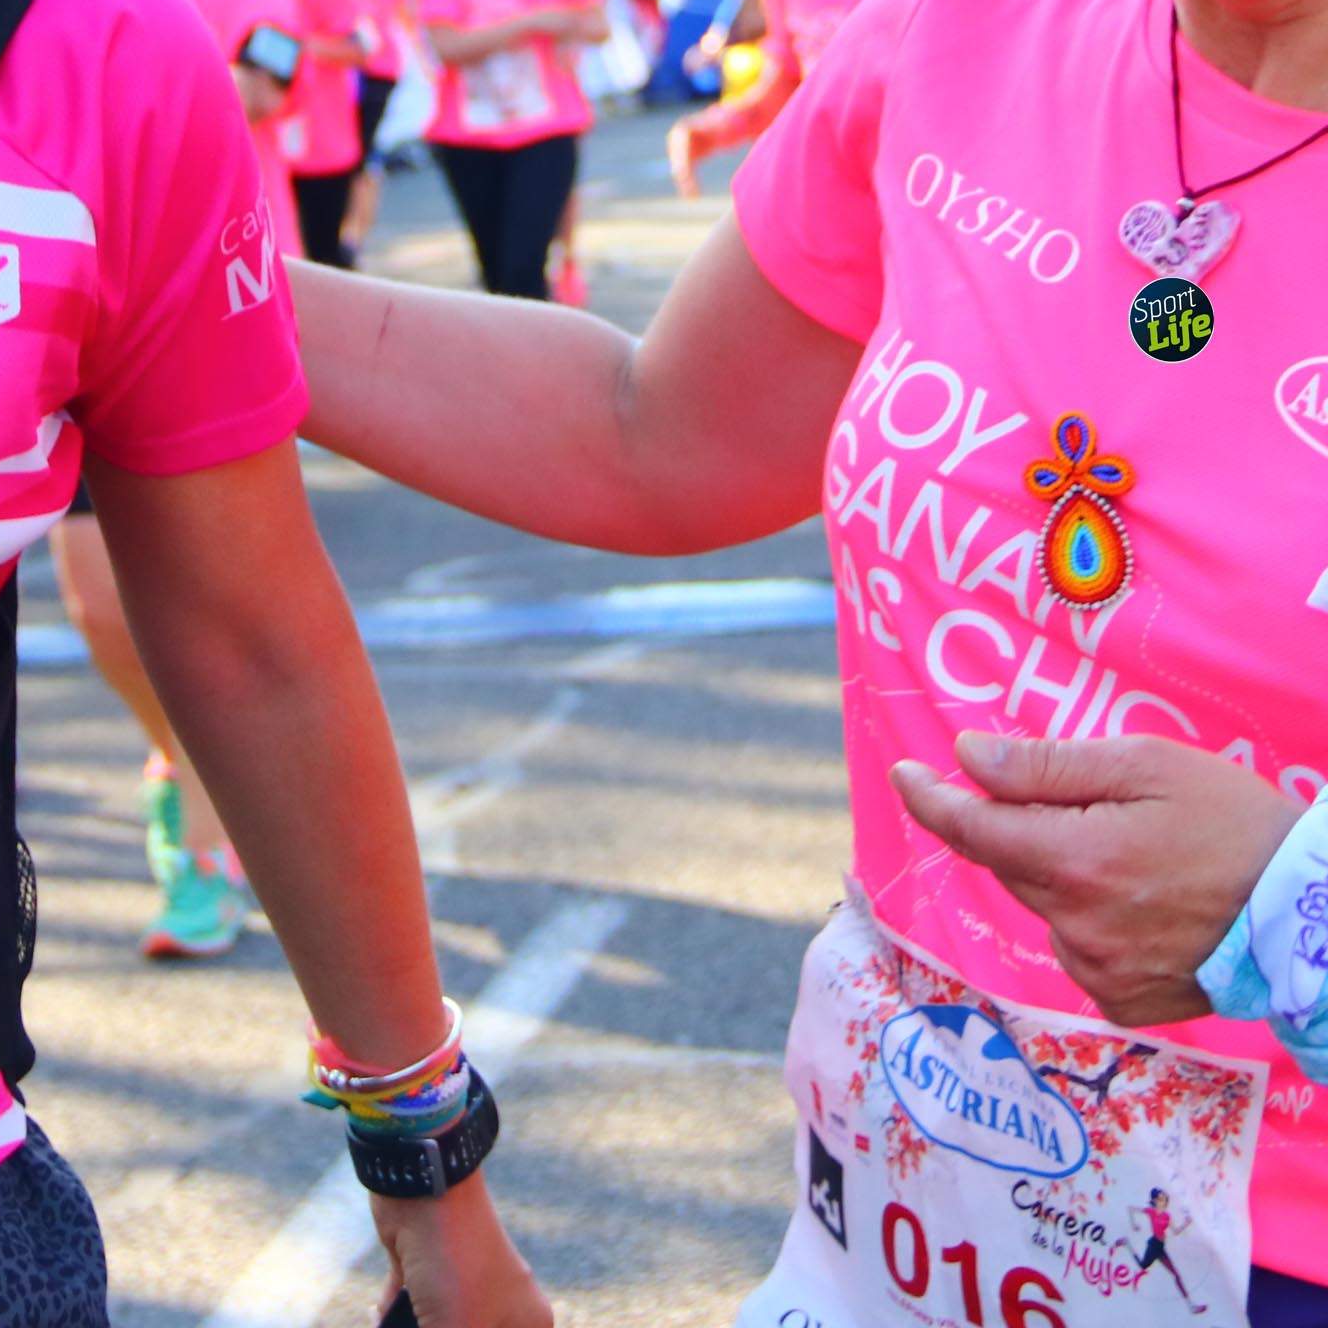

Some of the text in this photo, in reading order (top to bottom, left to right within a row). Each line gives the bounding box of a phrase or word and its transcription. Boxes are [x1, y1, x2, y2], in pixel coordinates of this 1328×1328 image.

[904, 152, 1081, 284] OYSHO
[850, 327, 1030, 477] HOY
[840, 542, 904, 652] AS
[889, 1025, 1066, 1165] ASTURIANA
[881, 1201, 1070, 1328] 016
[1011, 1178, 1107, 1246] Carrera
[1062, 1237, 1150, 1298] Mujer
